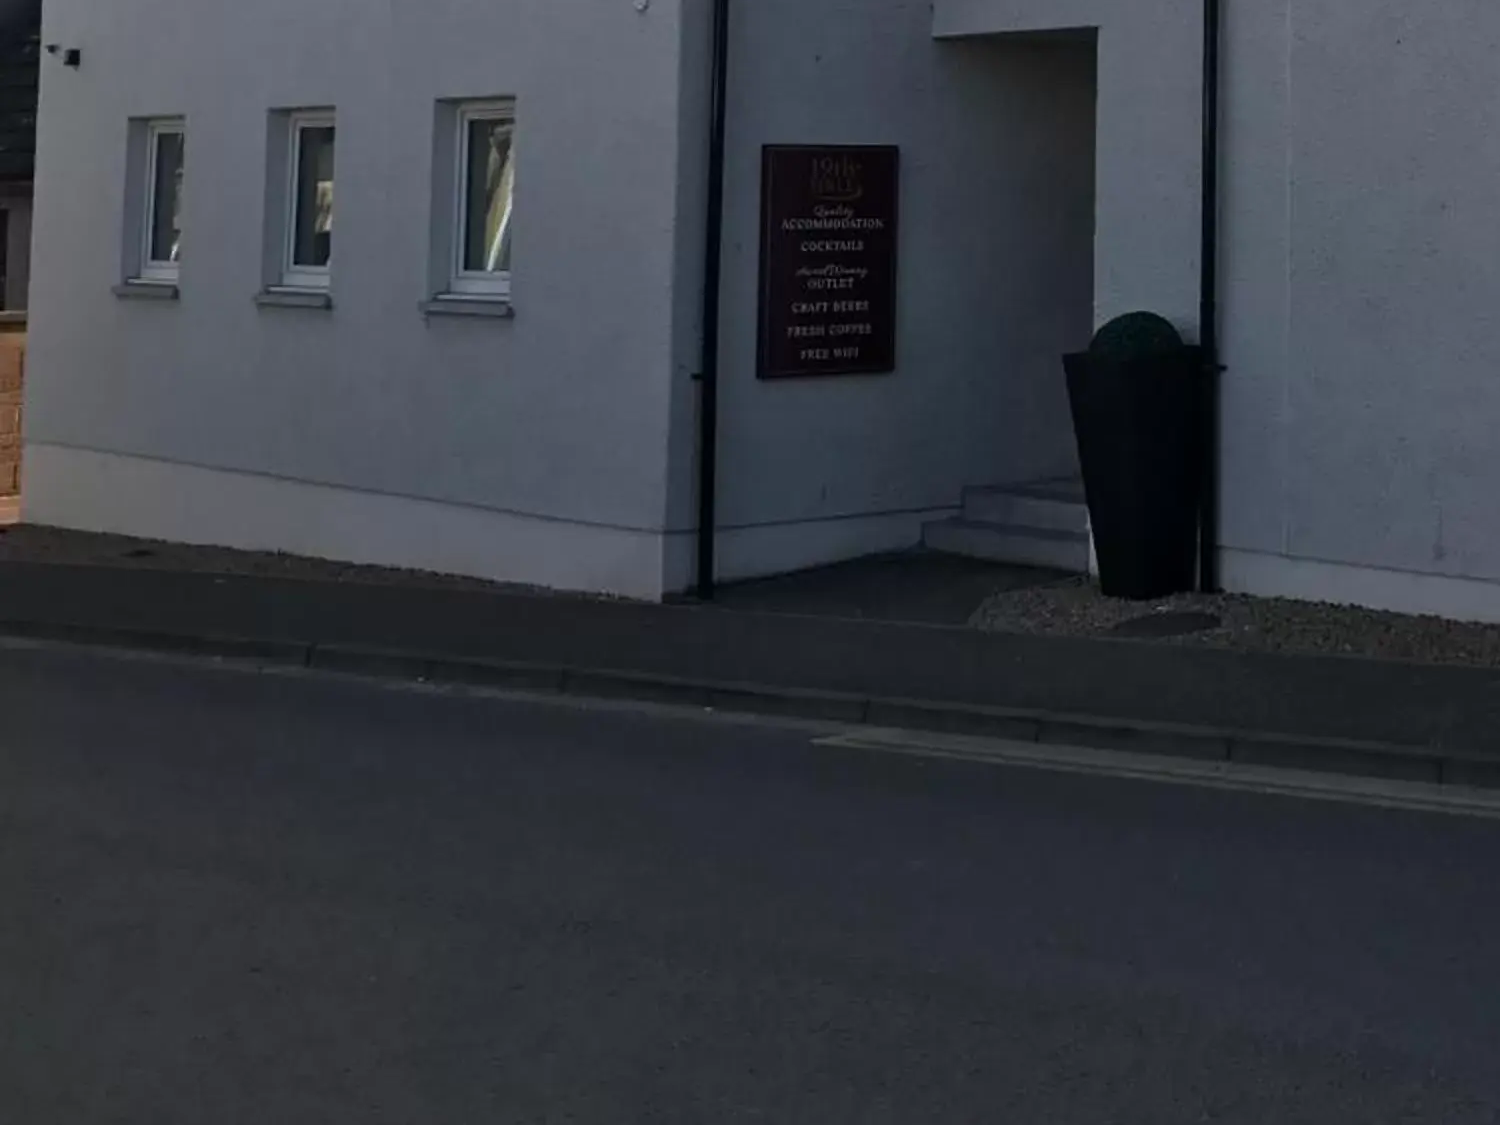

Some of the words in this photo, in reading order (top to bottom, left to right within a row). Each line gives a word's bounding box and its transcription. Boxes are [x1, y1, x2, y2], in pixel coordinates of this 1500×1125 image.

[782, 218, 884, 231] ACCOMMODATION
[800, 239, 864, 252] COCKTAILS
[807, 277, 854, 290] OUTLET
[790, 301, 828, 315] CRAFT
[832, 299, 869, 312] BEERS
[787, 324, 825, 339] FRESH
[828, 323, 872, 336] COFFEE
[800, 348, 830, 360] FREE
[833, 346, 859, 359] WIFI
